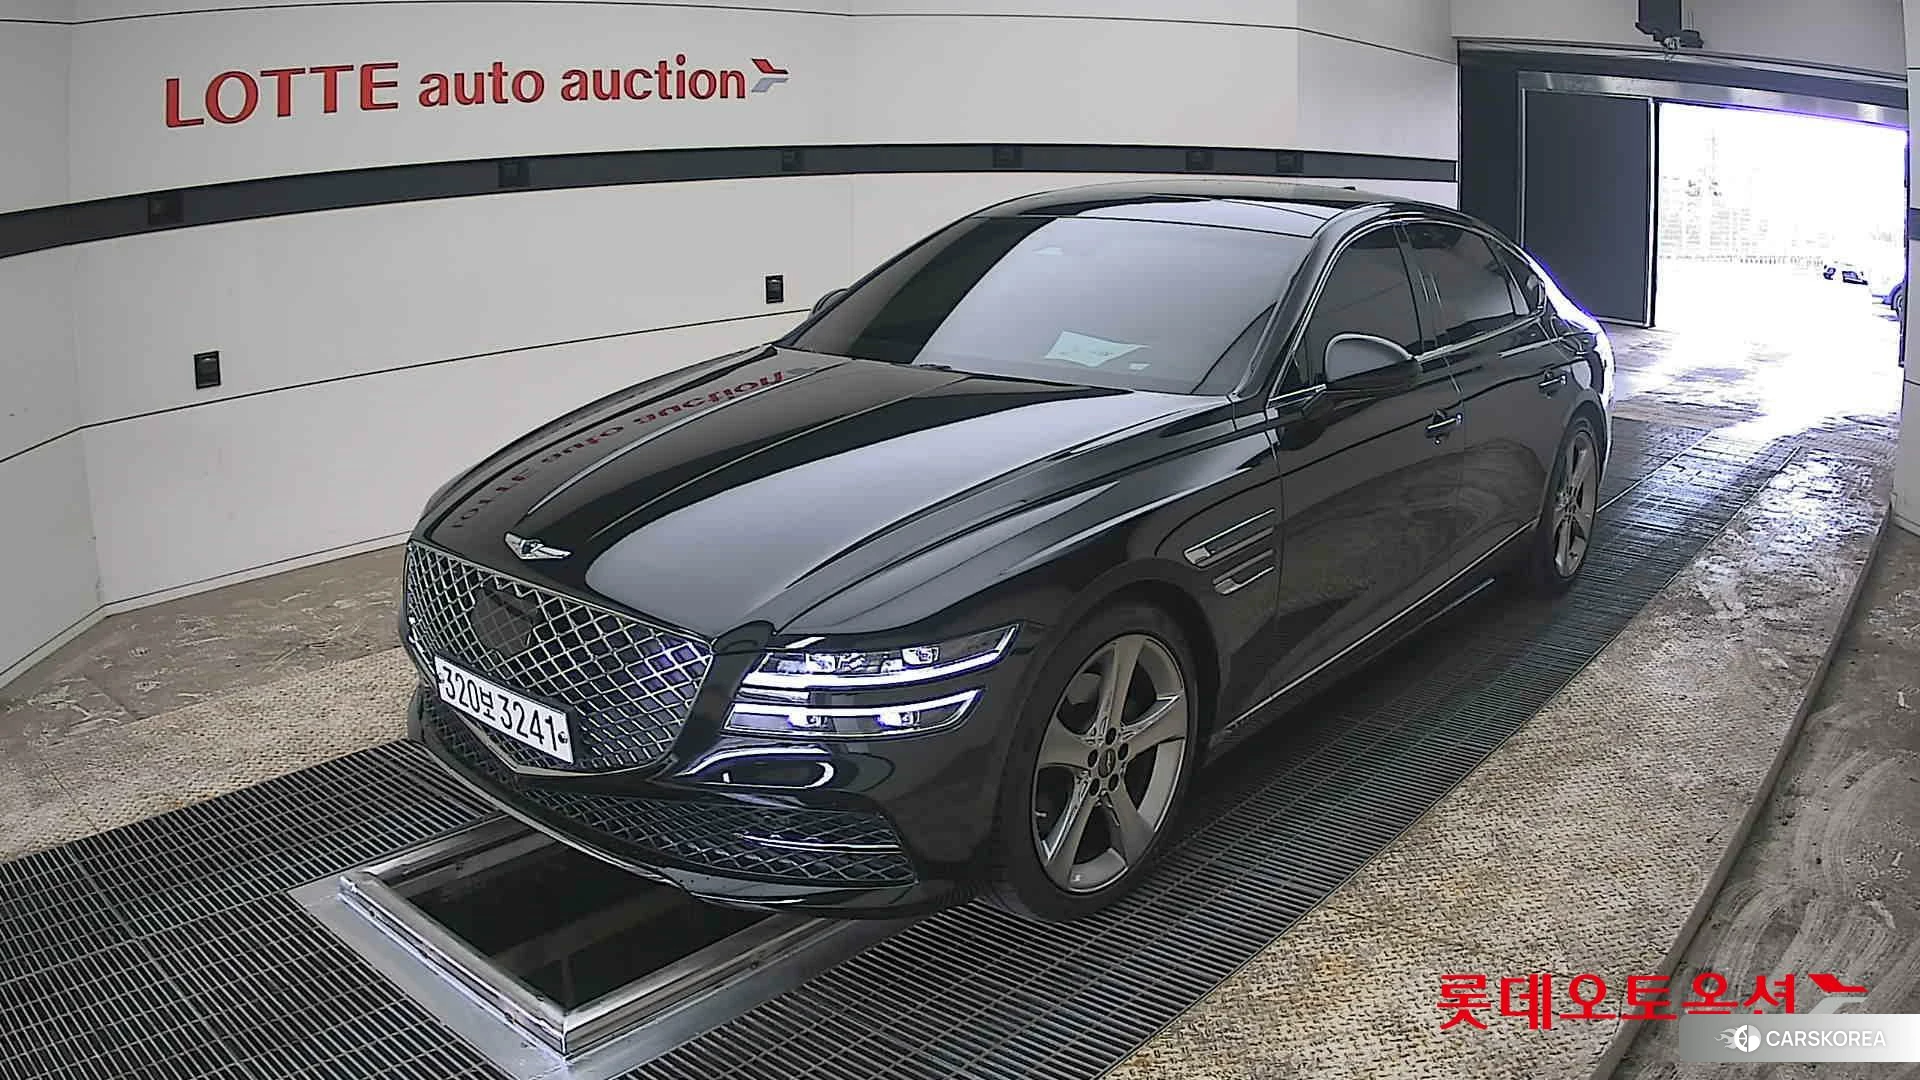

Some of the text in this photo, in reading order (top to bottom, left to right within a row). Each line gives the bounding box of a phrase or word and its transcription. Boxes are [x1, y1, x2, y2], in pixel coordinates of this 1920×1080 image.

[166, 54, 747, 127] LOTTE auto auction
